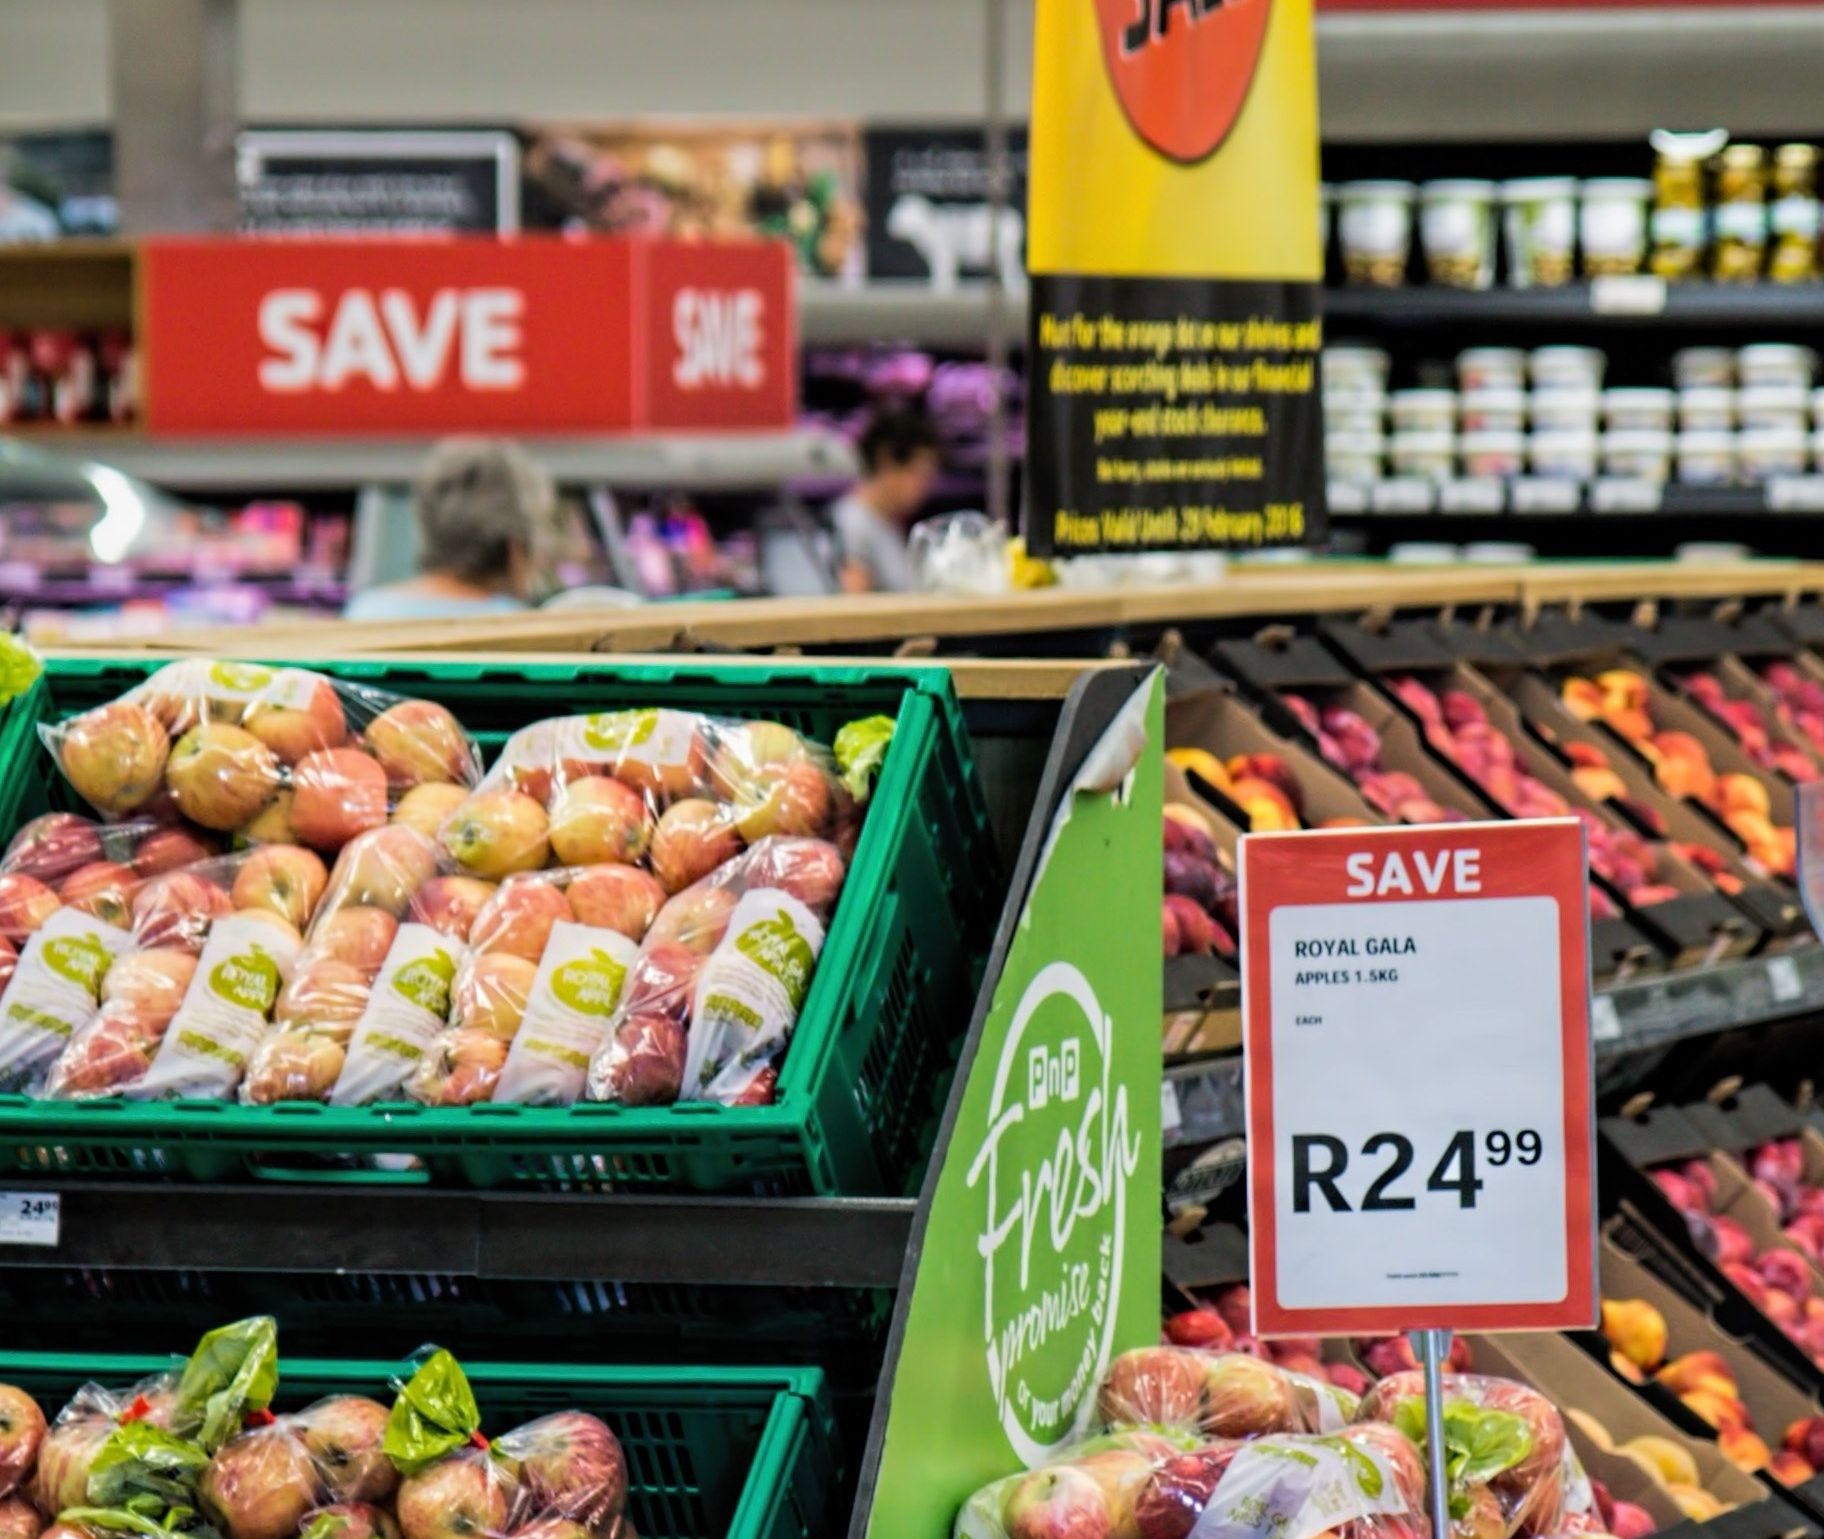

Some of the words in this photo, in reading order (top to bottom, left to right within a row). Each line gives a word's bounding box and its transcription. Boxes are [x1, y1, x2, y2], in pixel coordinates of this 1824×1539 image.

[257, 289, 526, 390] SAVE
[672, 289, 766, 389] SAVE
[1346, 849, 1482, 897] SAVE
[1295, 939, 1360, 959] ROYAL
[1365, 937, 1417, 956] GALA
[1295, 970, 1350, 986] APPLES
[1354, 968, 1399, 985] 1.5KG
[1295, 1015, 1323, 1026] EACH
[1029, 1038, 1080, 1110] PnP
[966, 1014, 1142, 1290] Fresh
[998, 1262, 1091, 1421] promise
[1018, 1379, 1031, 1411] or
[1032, 1396, 1059, 1431] your
[1060, 1327, 1097, 1420] money
[1091, 1235, 1112, 1326] back
